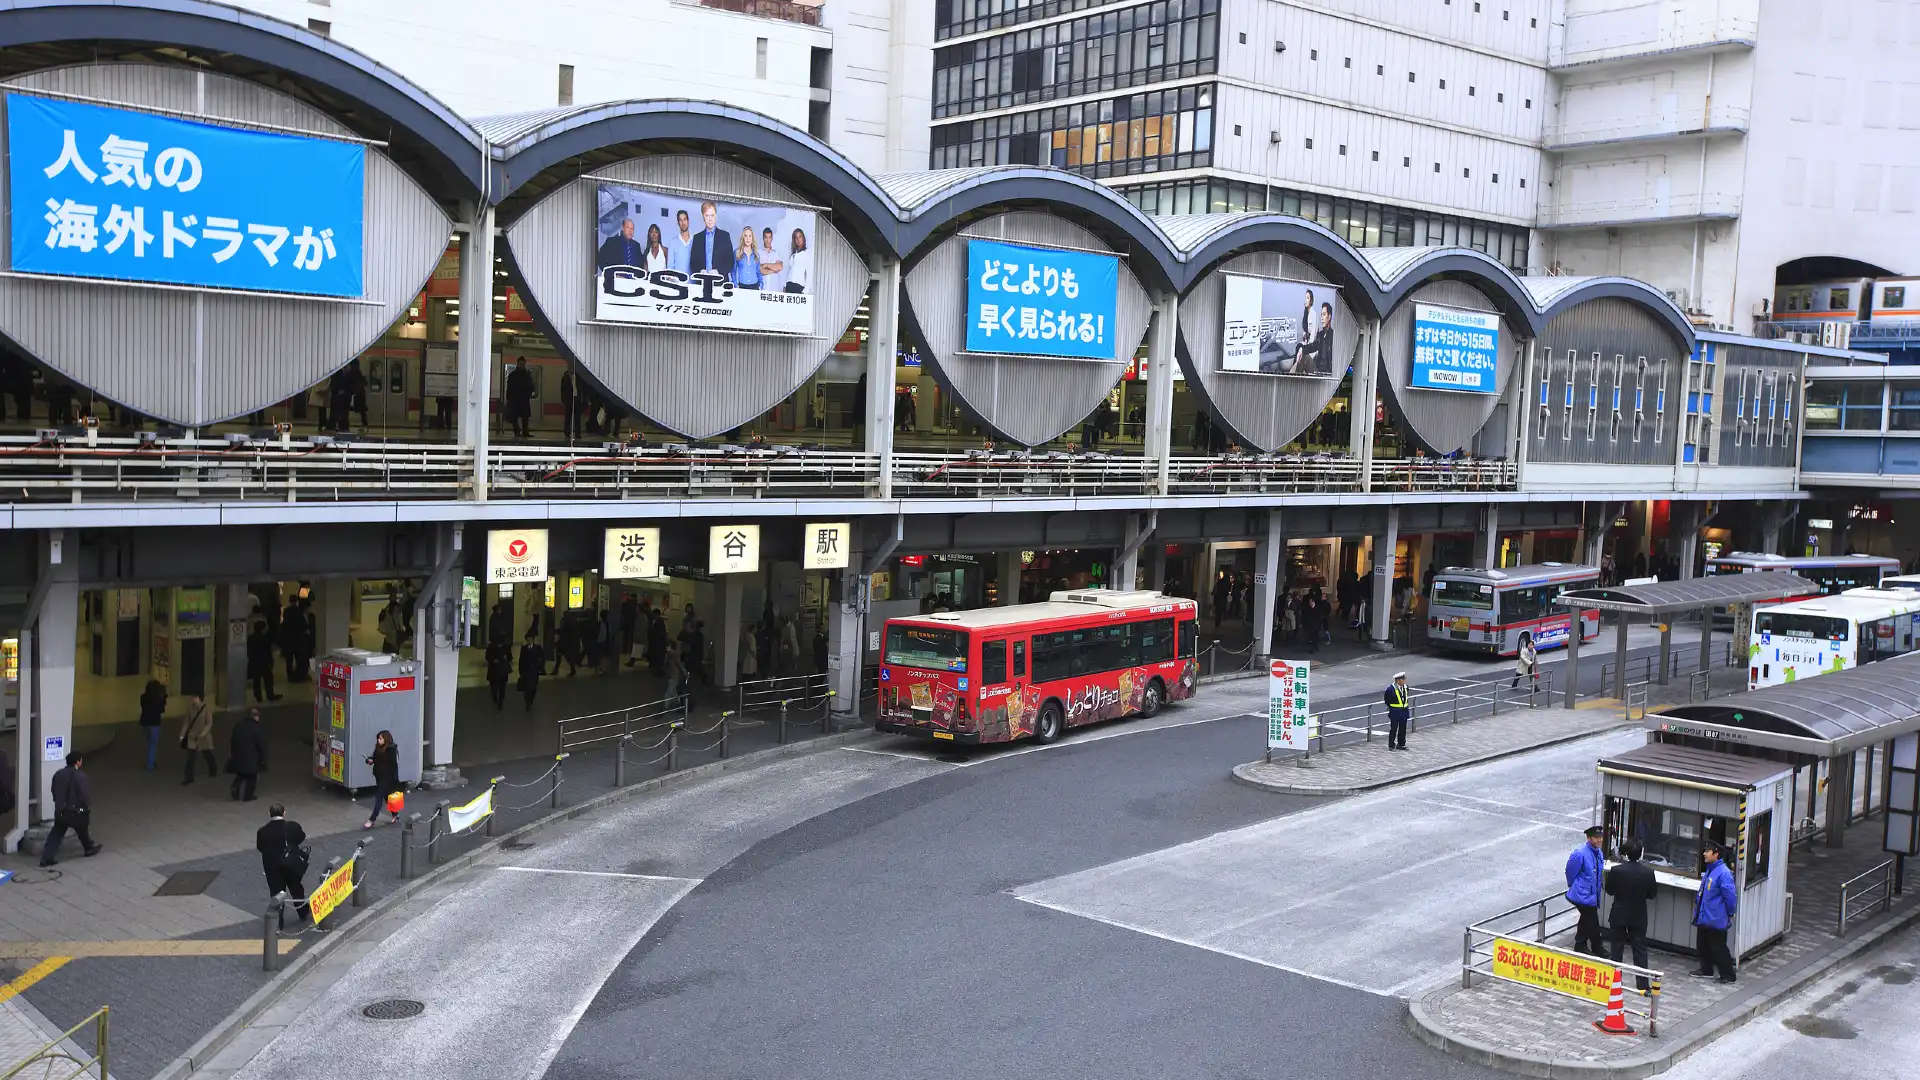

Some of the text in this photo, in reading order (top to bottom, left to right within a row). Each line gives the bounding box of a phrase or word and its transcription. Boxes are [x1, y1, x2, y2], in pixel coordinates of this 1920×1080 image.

[44, 129, 203, 193] 人気の
[44, 198, 338, 272] 海外ドラマが
[980, 259, 1080, 300] どこよりも
[978, 303, 1105, 345] 早く見られる!
[1416, 326, 1495, 351] まずは今日から15日間、
[1415, 345, 1494, 371] 無料でご覧ください。
[1433, 372, 1458, 382] WOWOW
[620, 533, 646, 562] 渋
[723, 531, 747, 559] 谷
[816, 528, 839, 555] 駅
[494, 565, 540, 579] 東急電鉄
[622, 564, 642, 574] Shibu
[816, 556, 838, 566] Station
[375, 680, 398, 691] 宝くじ
[907, 670, 940, 679] ノンステップバス
[1067, 684, 1119, 716] しっとりチョコ
[1293, 666, 1308, 727] 自転車は
[1497, 945, 1611, 990] あぶない!! 横断禁止
